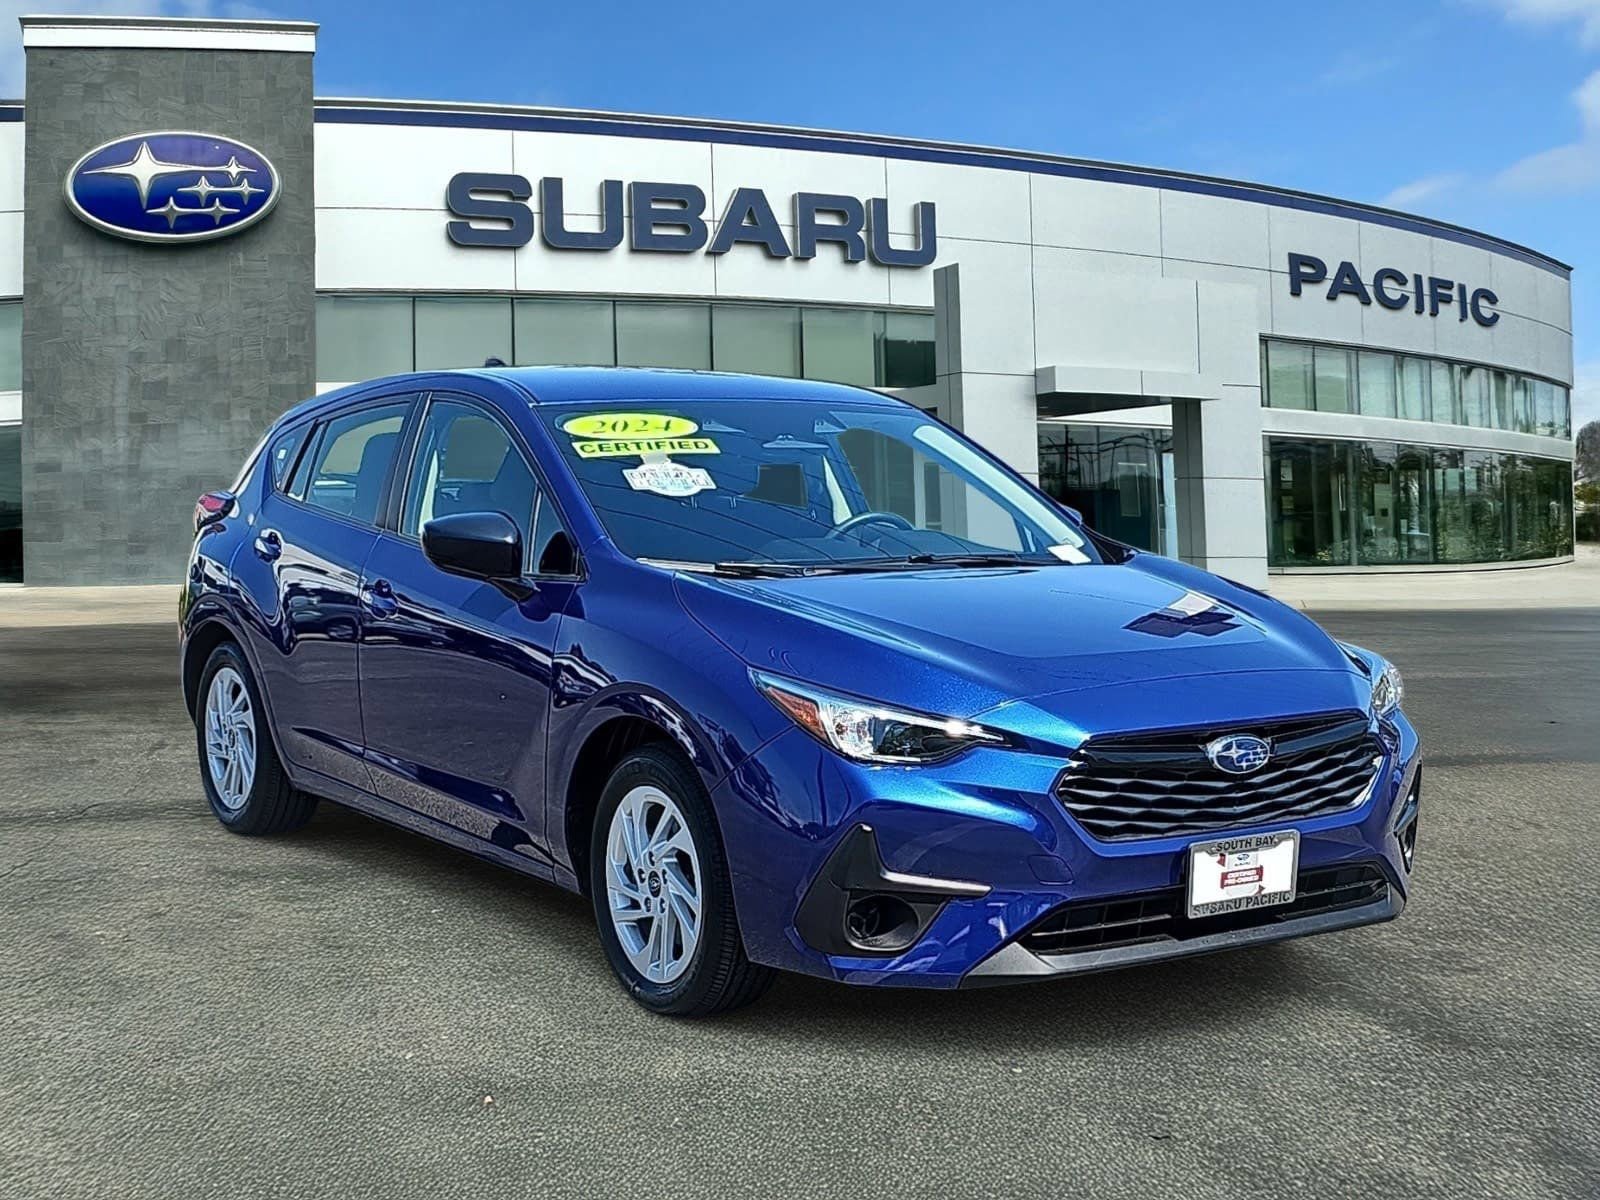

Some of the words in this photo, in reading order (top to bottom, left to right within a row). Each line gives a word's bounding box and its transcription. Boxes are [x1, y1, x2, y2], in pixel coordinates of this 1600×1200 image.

[447, 172, 936, 268] SUBARU
[1288, 252, 1500, 327] PACIFIC
[592, 419, 672, 434] 2024
[579, 440, 709, 454] CERTIFIED
[1217, 839, 1252, 853] SOUTH
[1255, 835, 1276, 847] BAY
[1245, 891, 1291, 908] PACIFIC
